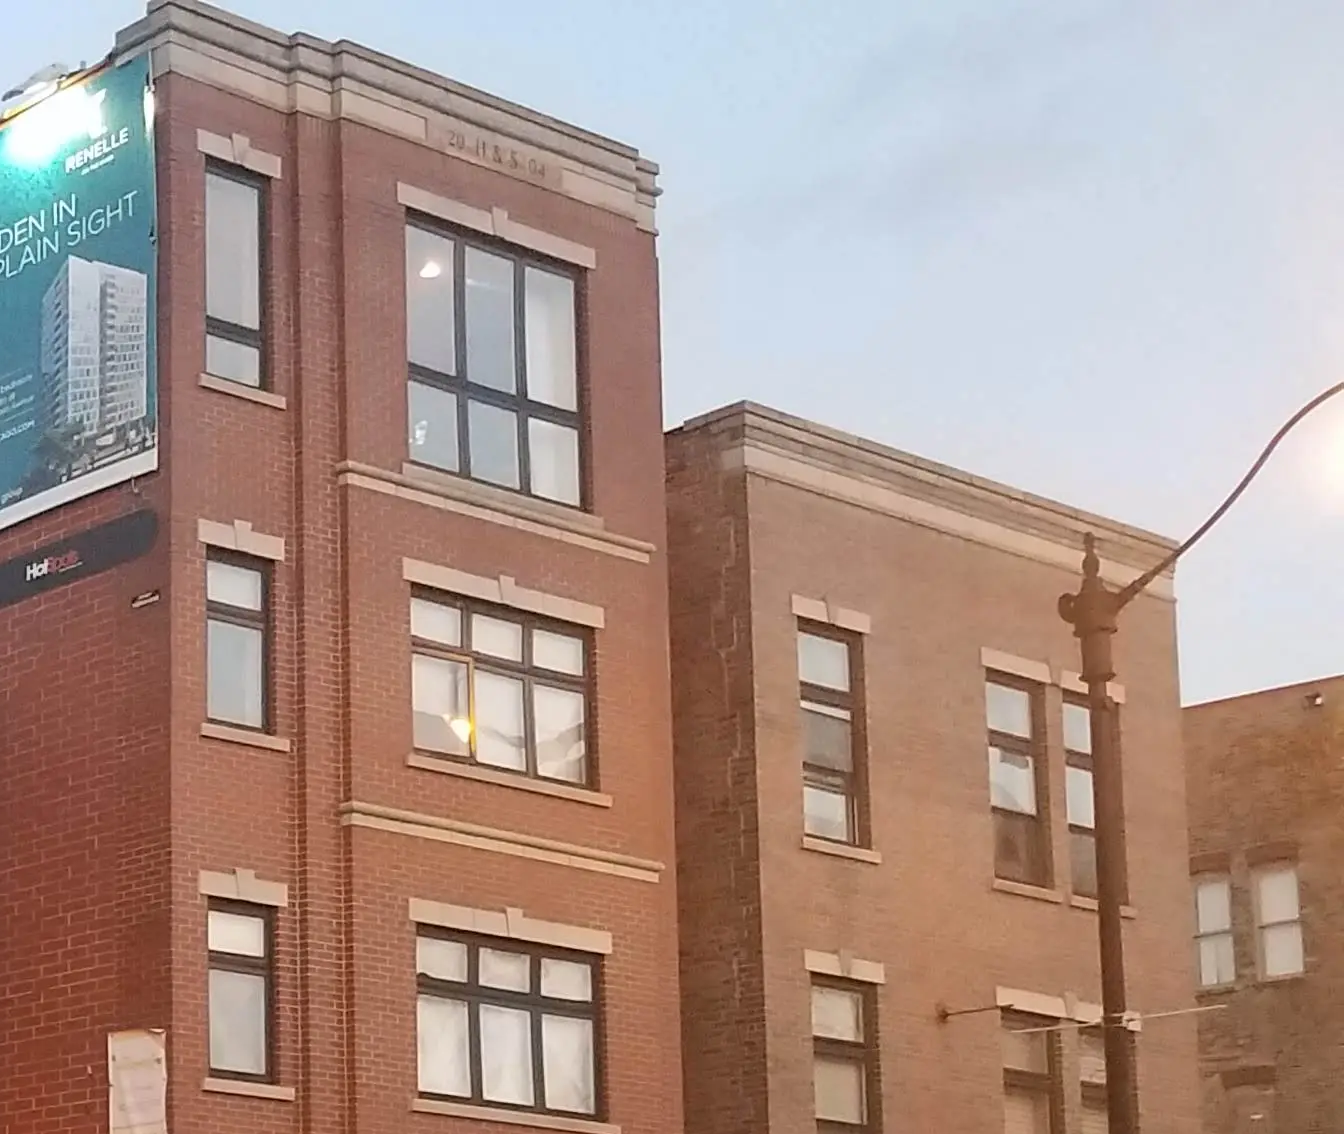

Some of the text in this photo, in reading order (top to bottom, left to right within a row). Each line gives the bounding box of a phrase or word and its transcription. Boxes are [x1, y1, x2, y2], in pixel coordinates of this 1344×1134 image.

[64, 127, 129, 173] RENELLE
[52, 193, 76, 226] IN
[67, 190, 138, 246] SIGHT
